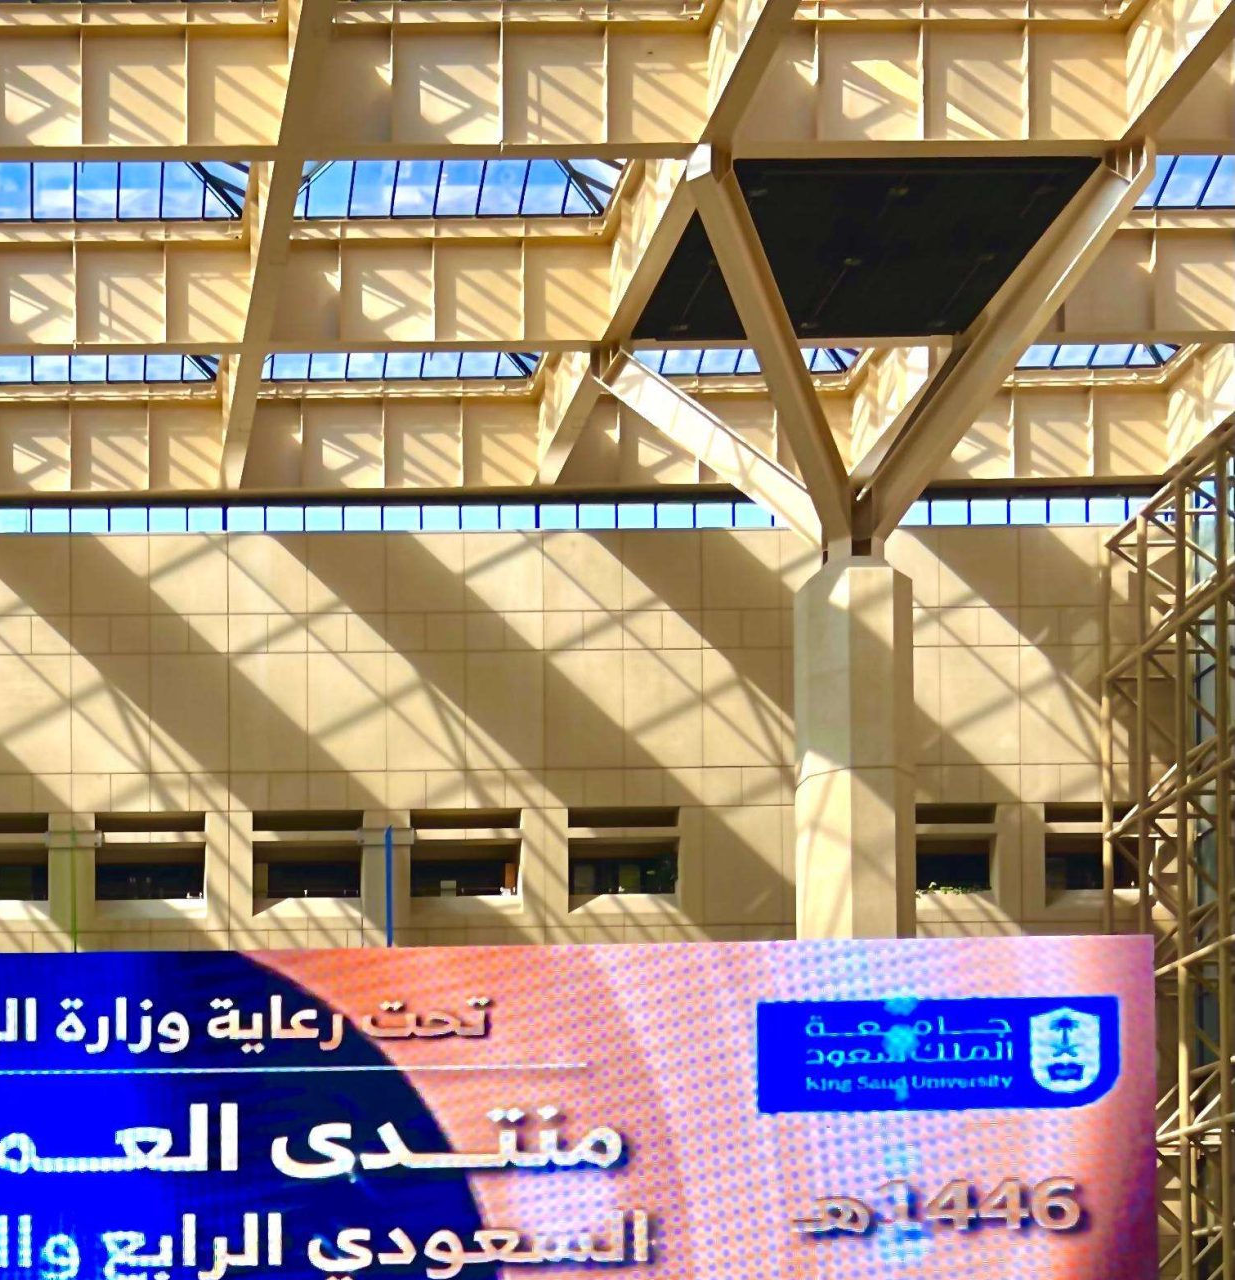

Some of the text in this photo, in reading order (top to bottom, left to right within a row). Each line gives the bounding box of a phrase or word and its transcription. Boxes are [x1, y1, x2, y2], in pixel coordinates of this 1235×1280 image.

[56, 997, 190, 1054] وزارة
[207, 996, 345, 1054] رعاية
[361, 996, 494, 1039] تحت
[805, 1015, 1013, 1039] جامعة
[805, 1041, 1014, 1068] الملك سعود
[806, 1074, 1014, 1093] King Saud University
[270, 1104, 626, 1178] منتدى
